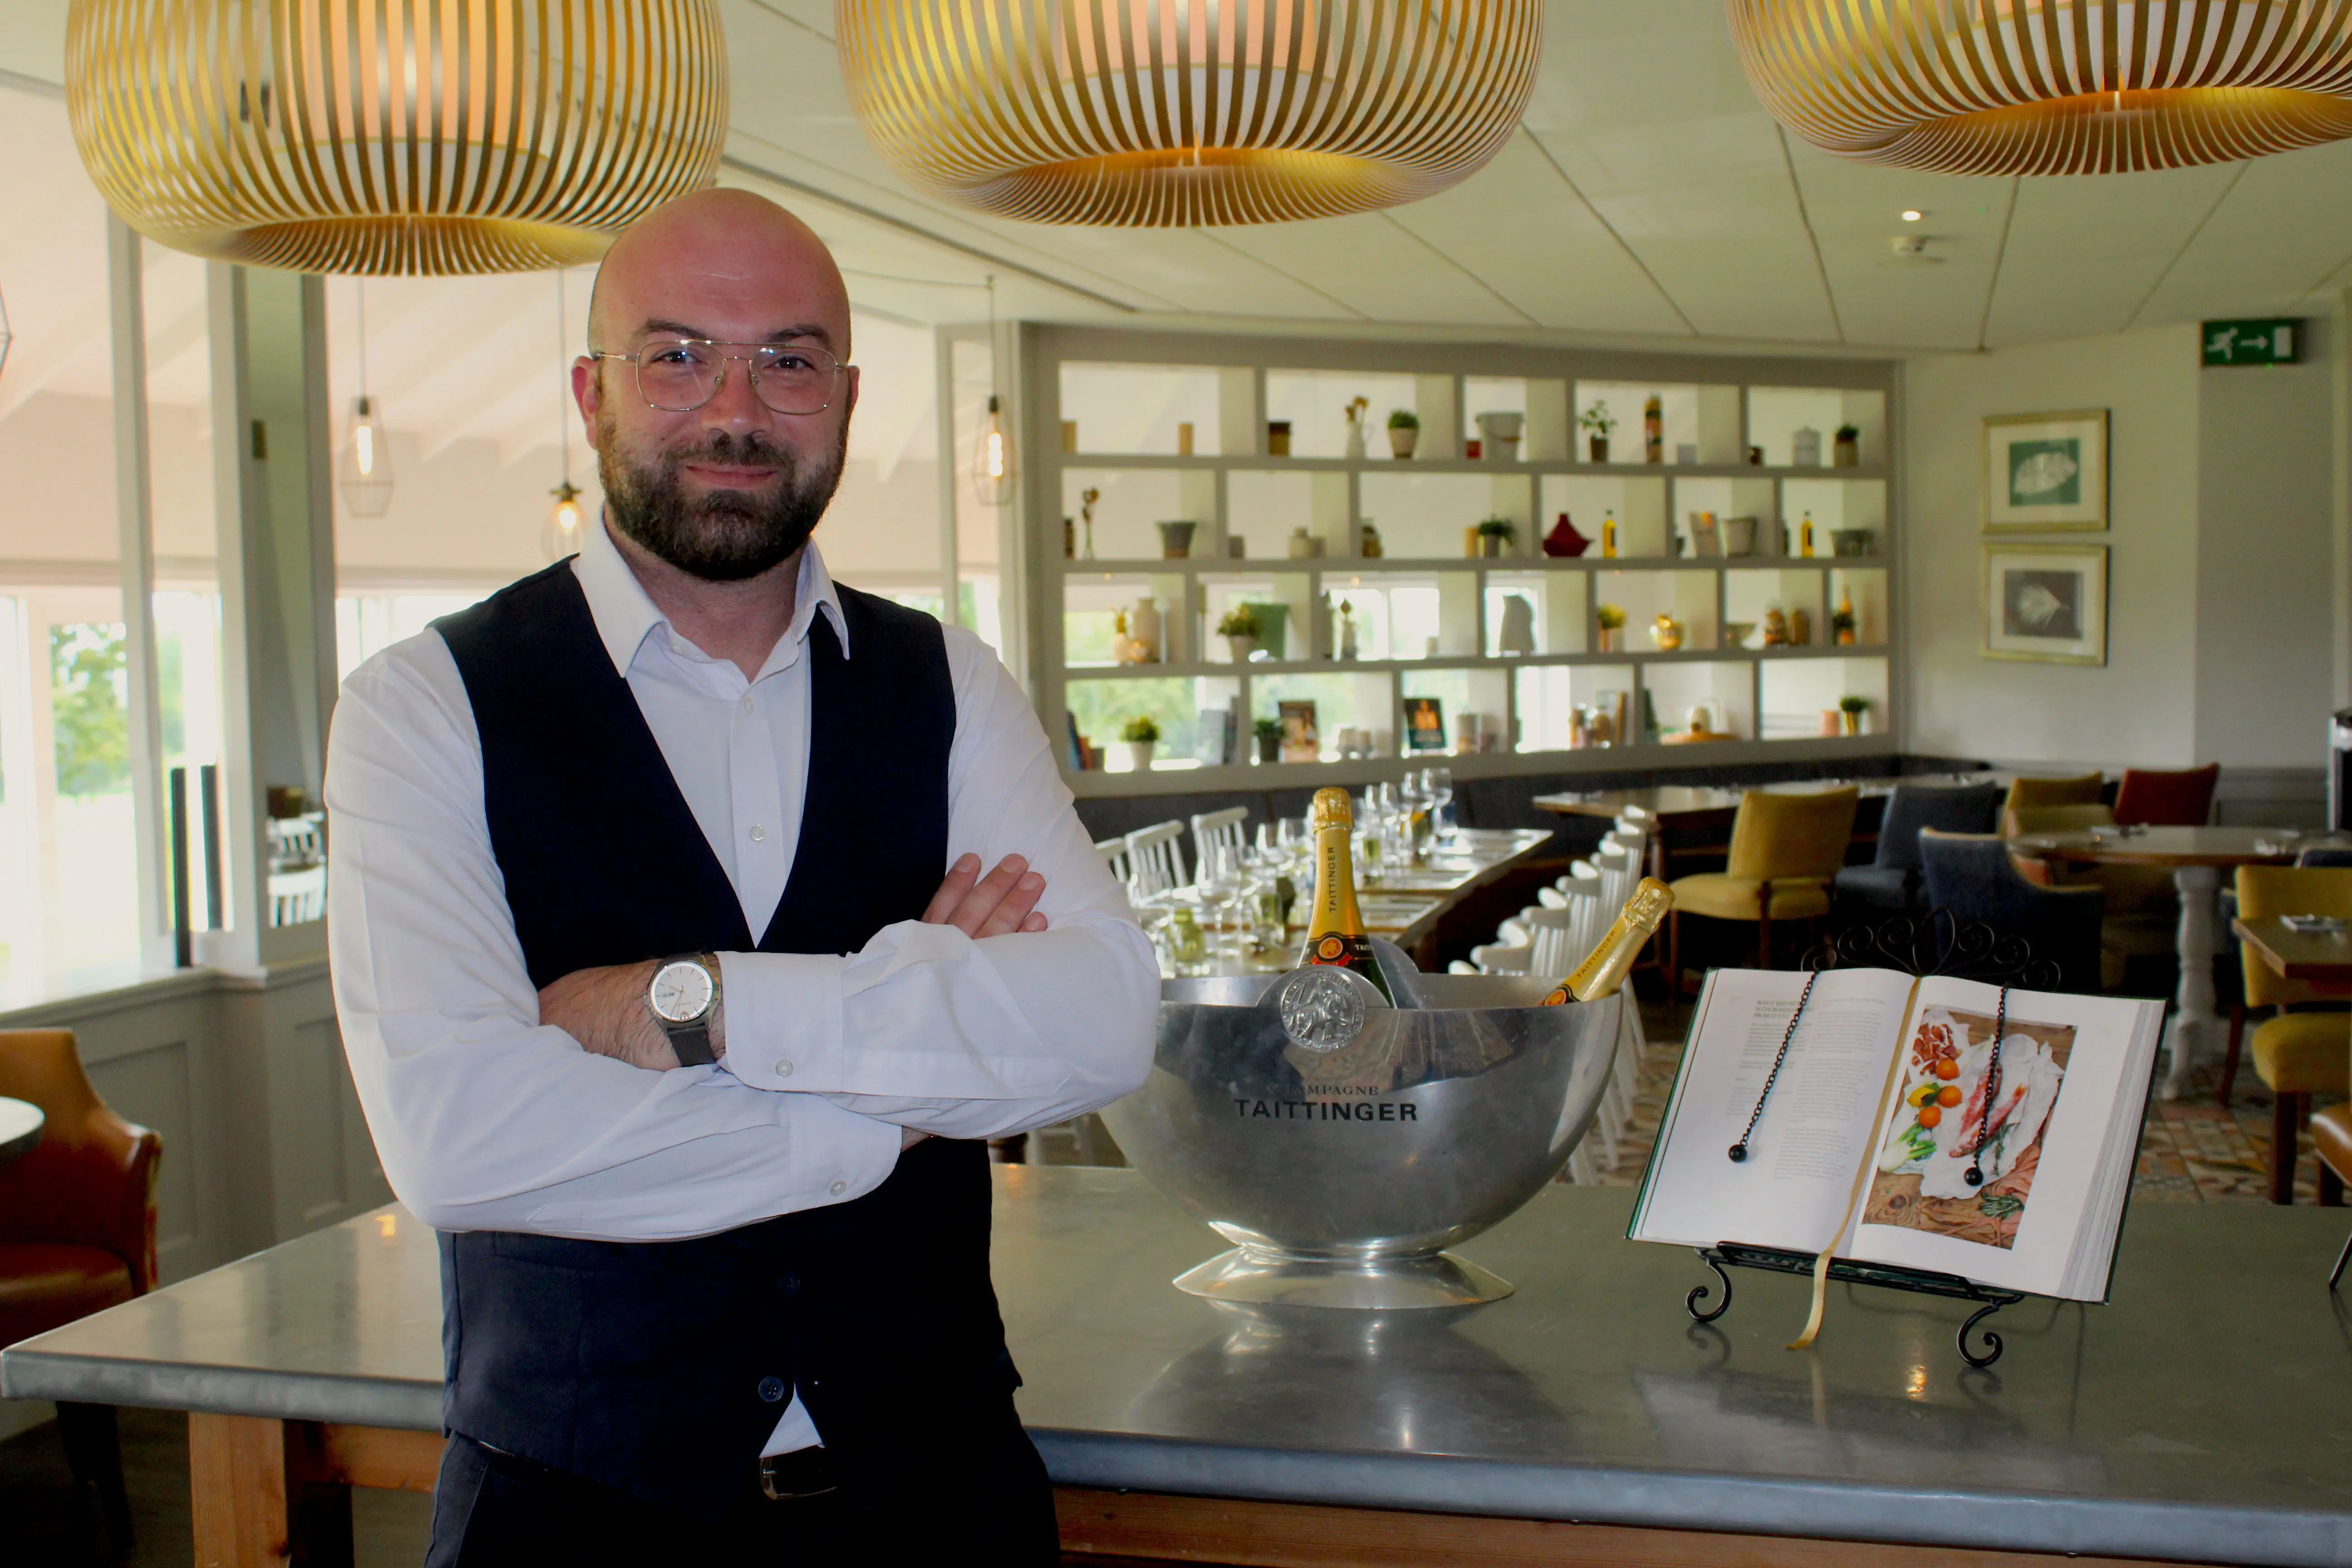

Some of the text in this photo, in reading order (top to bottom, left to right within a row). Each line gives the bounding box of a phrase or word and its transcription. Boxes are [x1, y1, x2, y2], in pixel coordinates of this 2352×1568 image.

[1328, 847, 1337, 913] TAITTINGER
[1578, 930, 1617, 978] TAITTINGER
[1271, 1083, 1378, 1096] CHAMPAGNE
[1234, 1099, 1418, 1121] TAITTINGER
